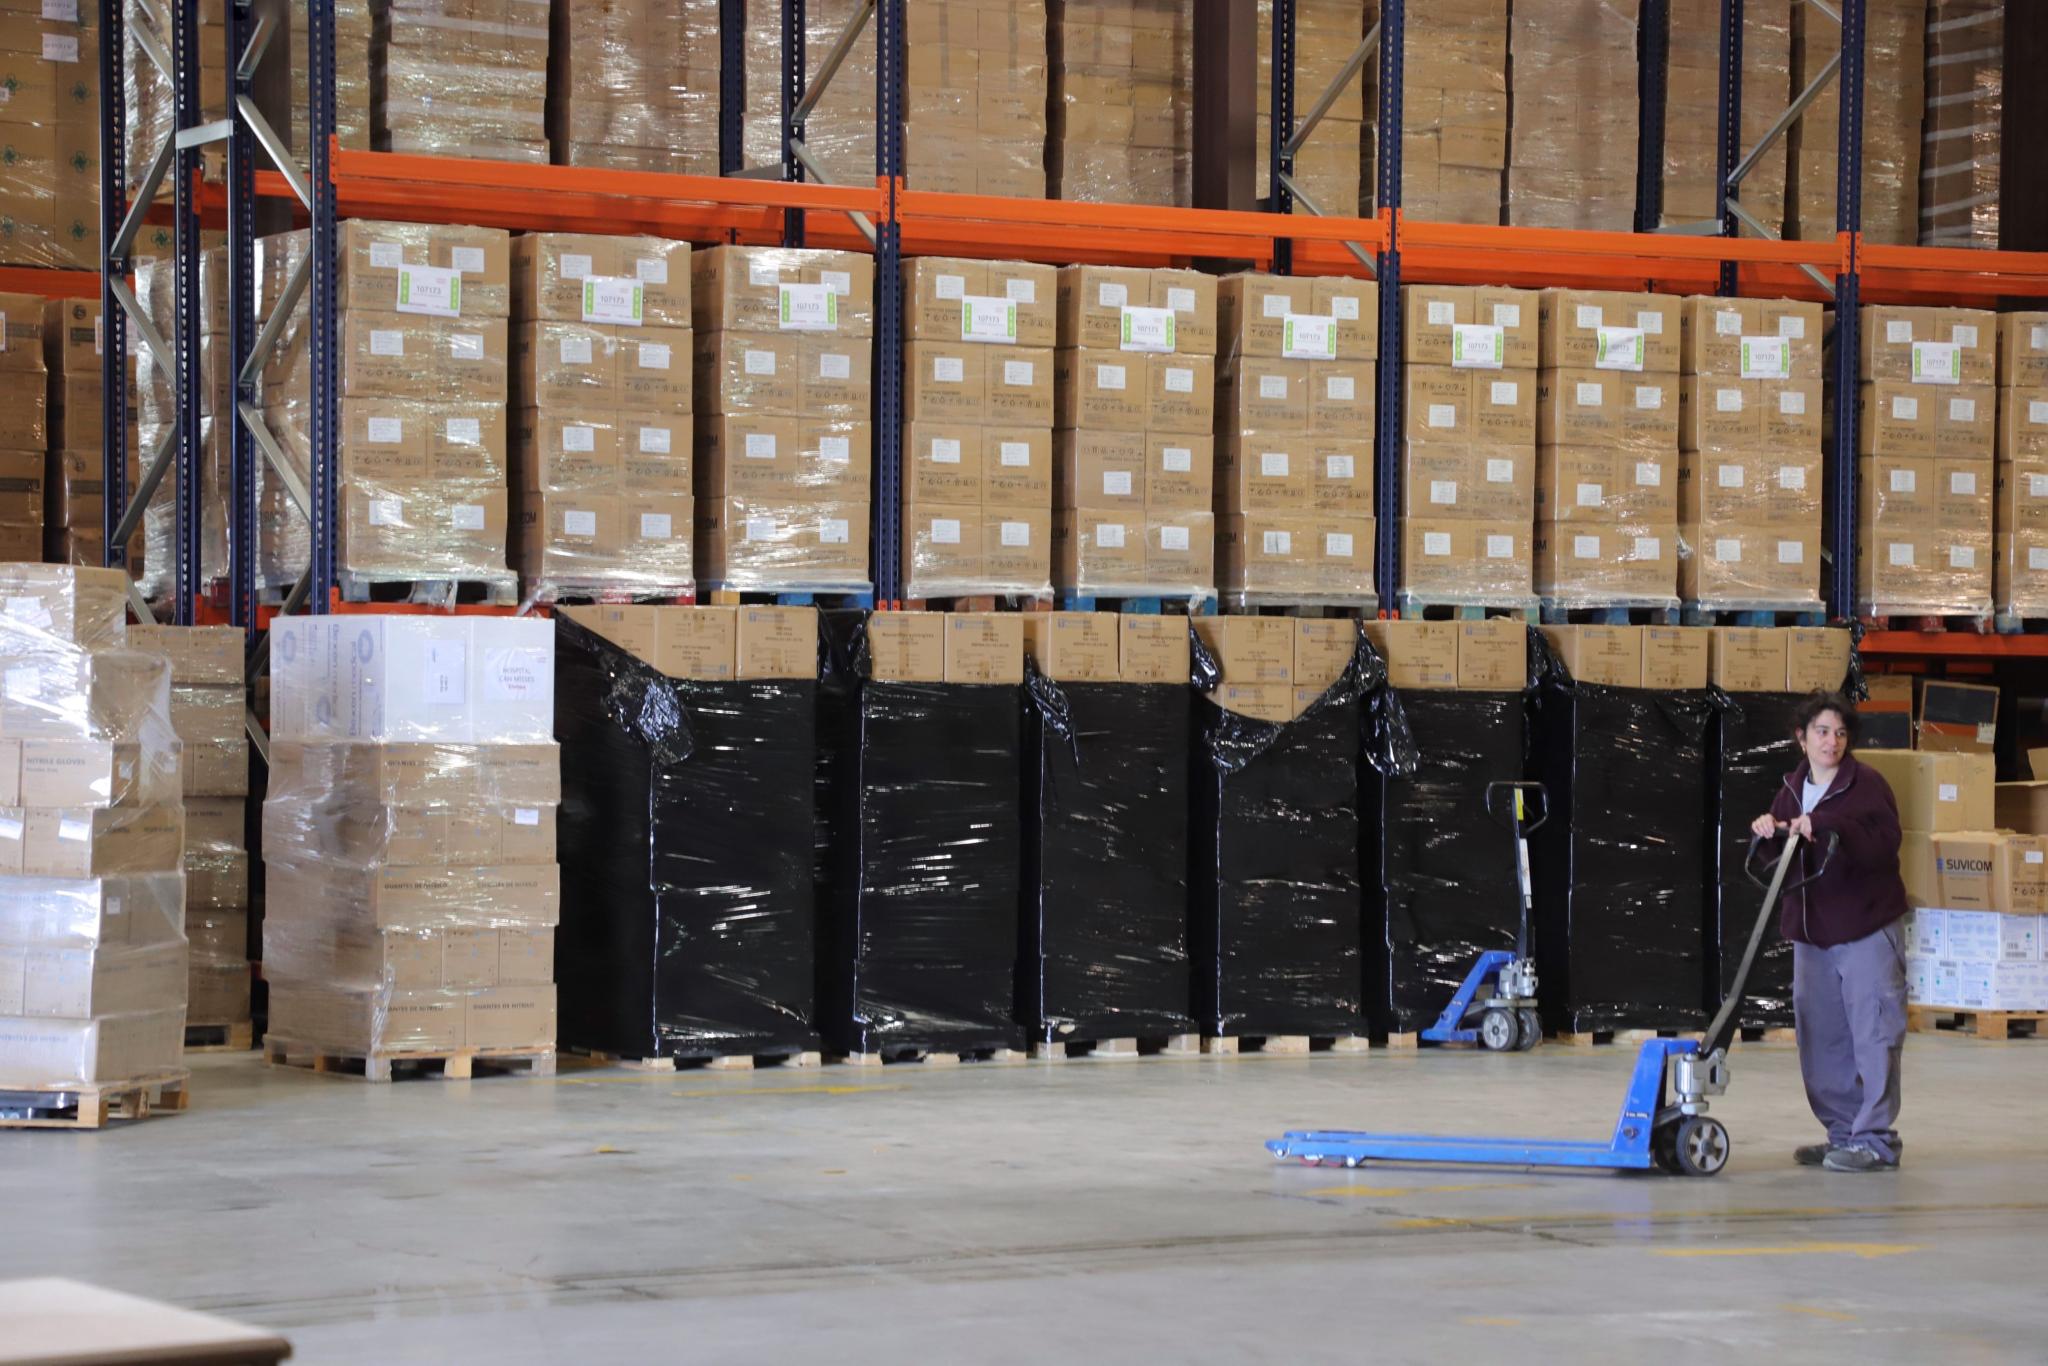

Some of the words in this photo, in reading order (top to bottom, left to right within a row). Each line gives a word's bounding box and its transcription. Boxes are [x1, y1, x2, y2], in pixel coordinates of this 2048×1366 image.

[416, 285, 442, 295] 107173
[600, 295, 625, 305] 107173
[978, 315, 1000, 323] 107173
[1468, 343, 1488, 351] 107173
[26, 757, 54, 765] NITRILE
[56, 758, 86, 766] GLOVES
[1946, 858, 1993, 872] SUVICOM
